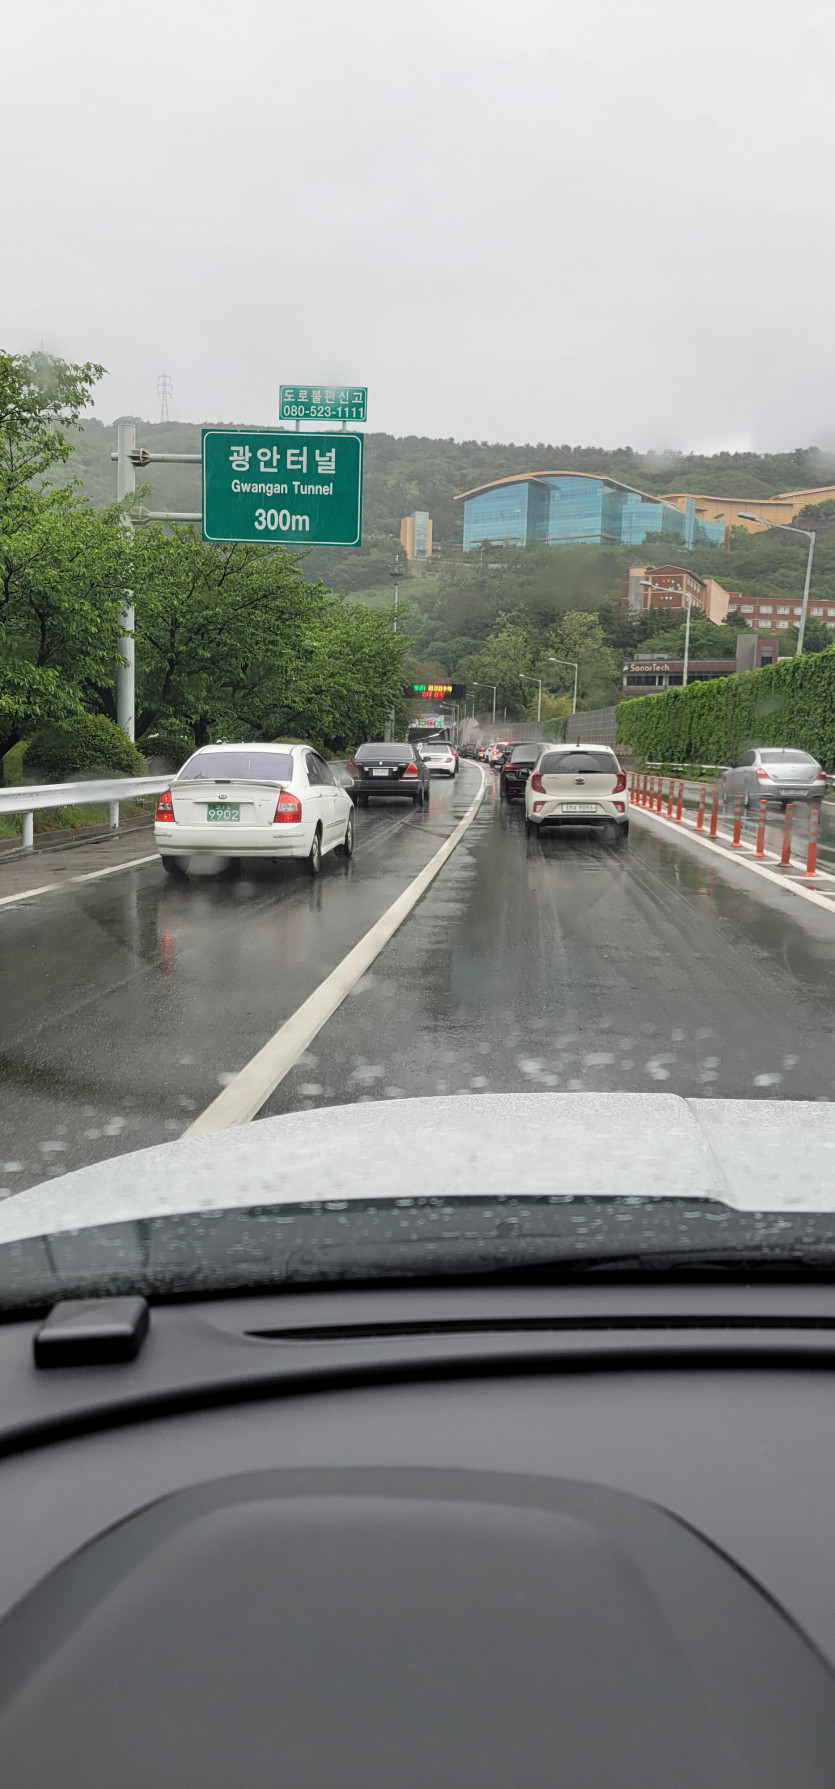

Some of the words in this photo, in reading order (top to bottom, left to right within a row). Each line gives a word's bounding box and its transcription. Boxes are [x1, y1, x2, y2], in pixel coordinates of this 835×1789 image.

[283, 389, 364, 405] 도로불편신고
[283, 405, 364, 419] 080-523-1111
[228, 445, 336, 475] 광안터널
[231, 479, 288, 497] Gwangan
[292, 481, 334, 496] Tunnel
[254, 508, 310, 532] 300m
[630, 663, 670, 672] SonarTech
[208, 809, 239, 820] 9902
